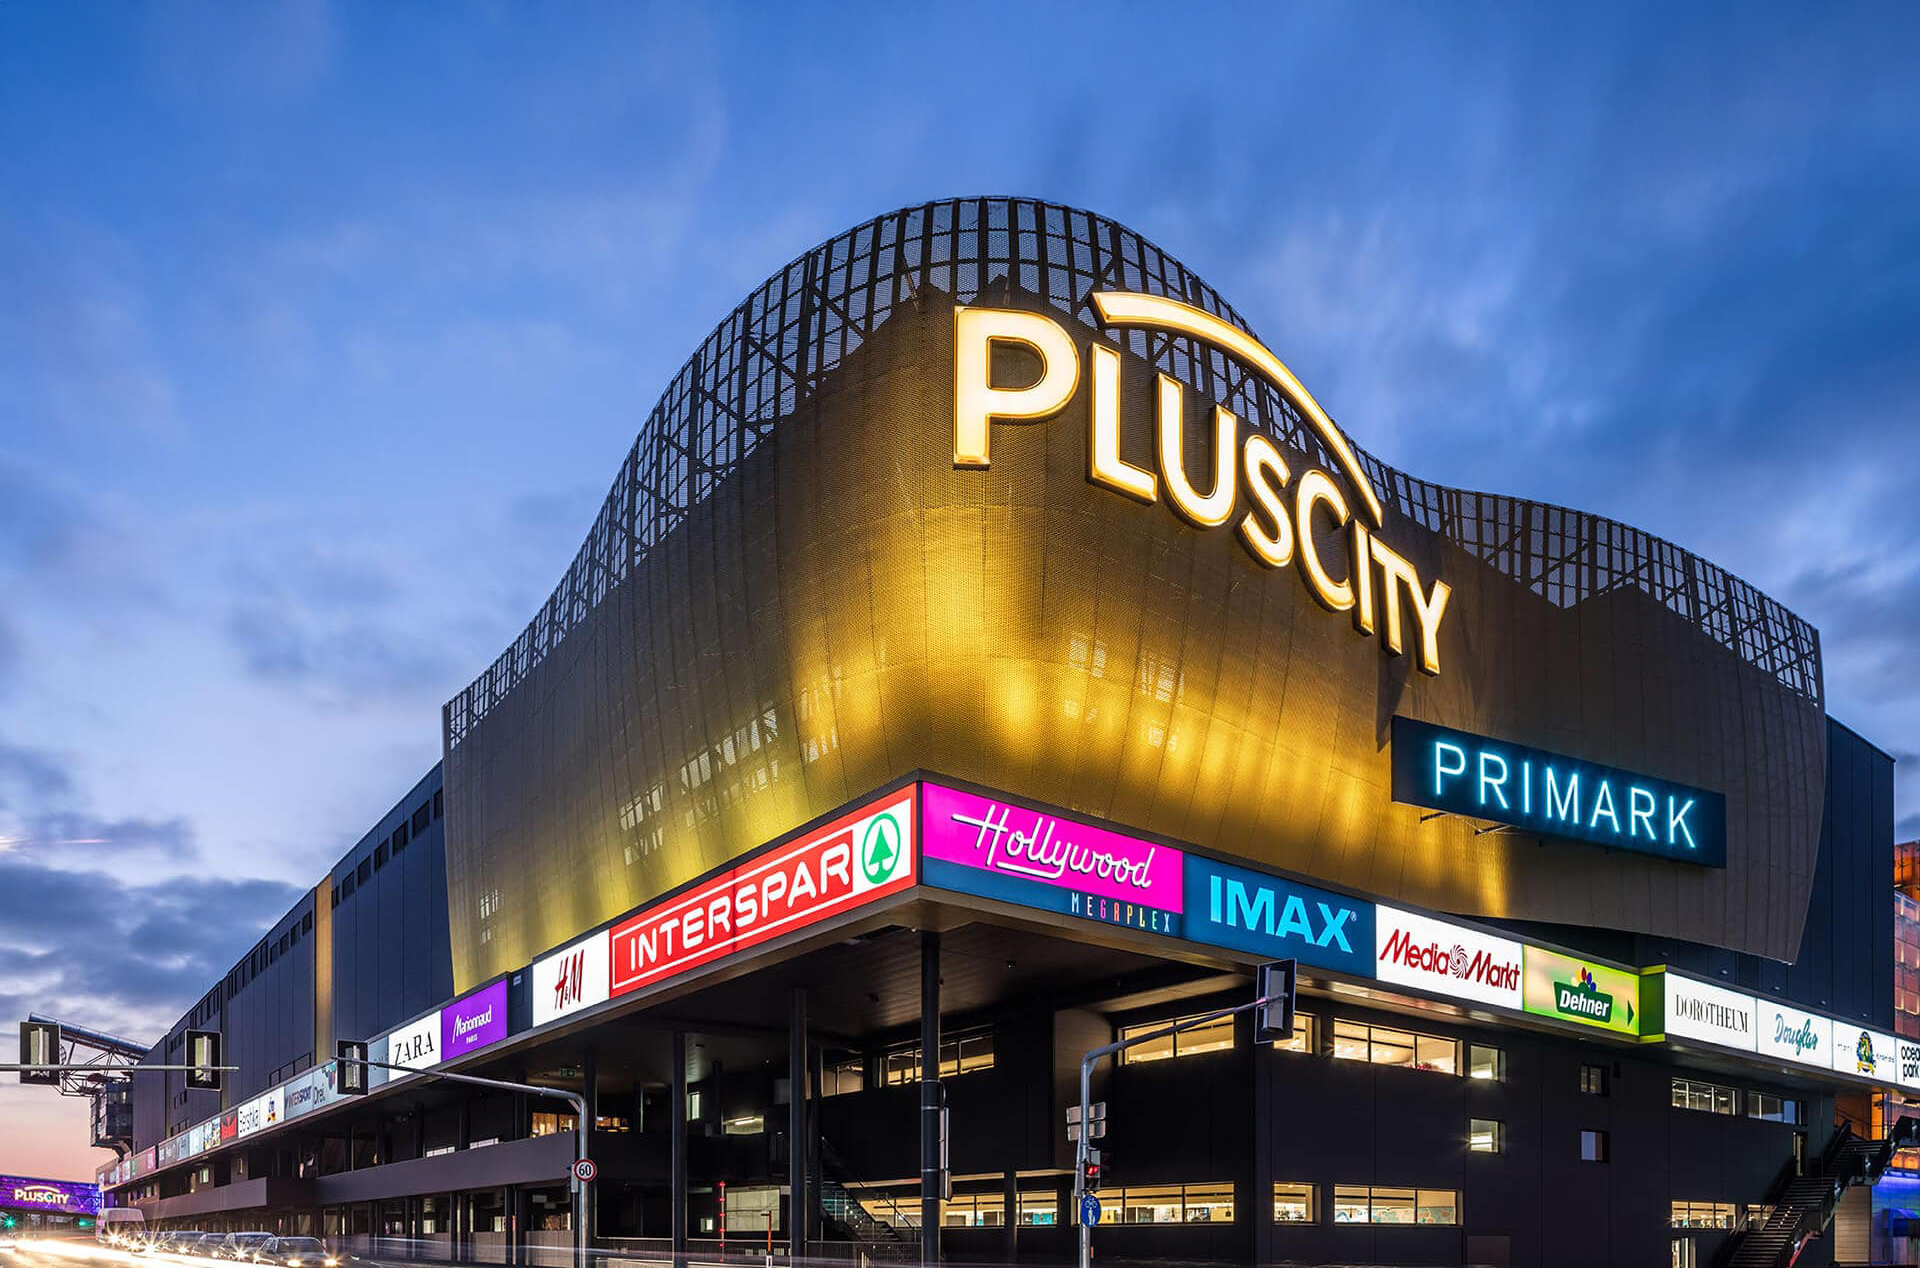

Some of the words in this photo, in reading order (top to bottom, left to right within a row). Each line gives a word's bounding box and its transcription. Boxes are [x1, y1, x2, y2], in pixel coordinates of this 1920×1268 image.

[953, 306, 1452, 676] PLUSCITY
[1435, 741, 1697, 848] PRIMARK
[952, 804, 1153, 889] Hollywood
[630, 842, 851, 971] INTERSPAR
[1070, 892, 1170, 933] MEGAPLEX
[554, 949, 584, 1010] H&M
[1379, 928, 1450, 975] Media
[1464, 949, 1521, 991] Markt
[1559, 989, 1610, 1017] Dehner
[1675, 994, 1749, 1033] DOROTHEUM
[394, 1031, 434, 1066] ZARA
[1774, 1013, 1818, 1056] Douglas
[1902, 1060, 1919, 1082] park
[578, 1164, 592, 1177] 60
[14, 1187, 70, 1205] PLUSCITY
